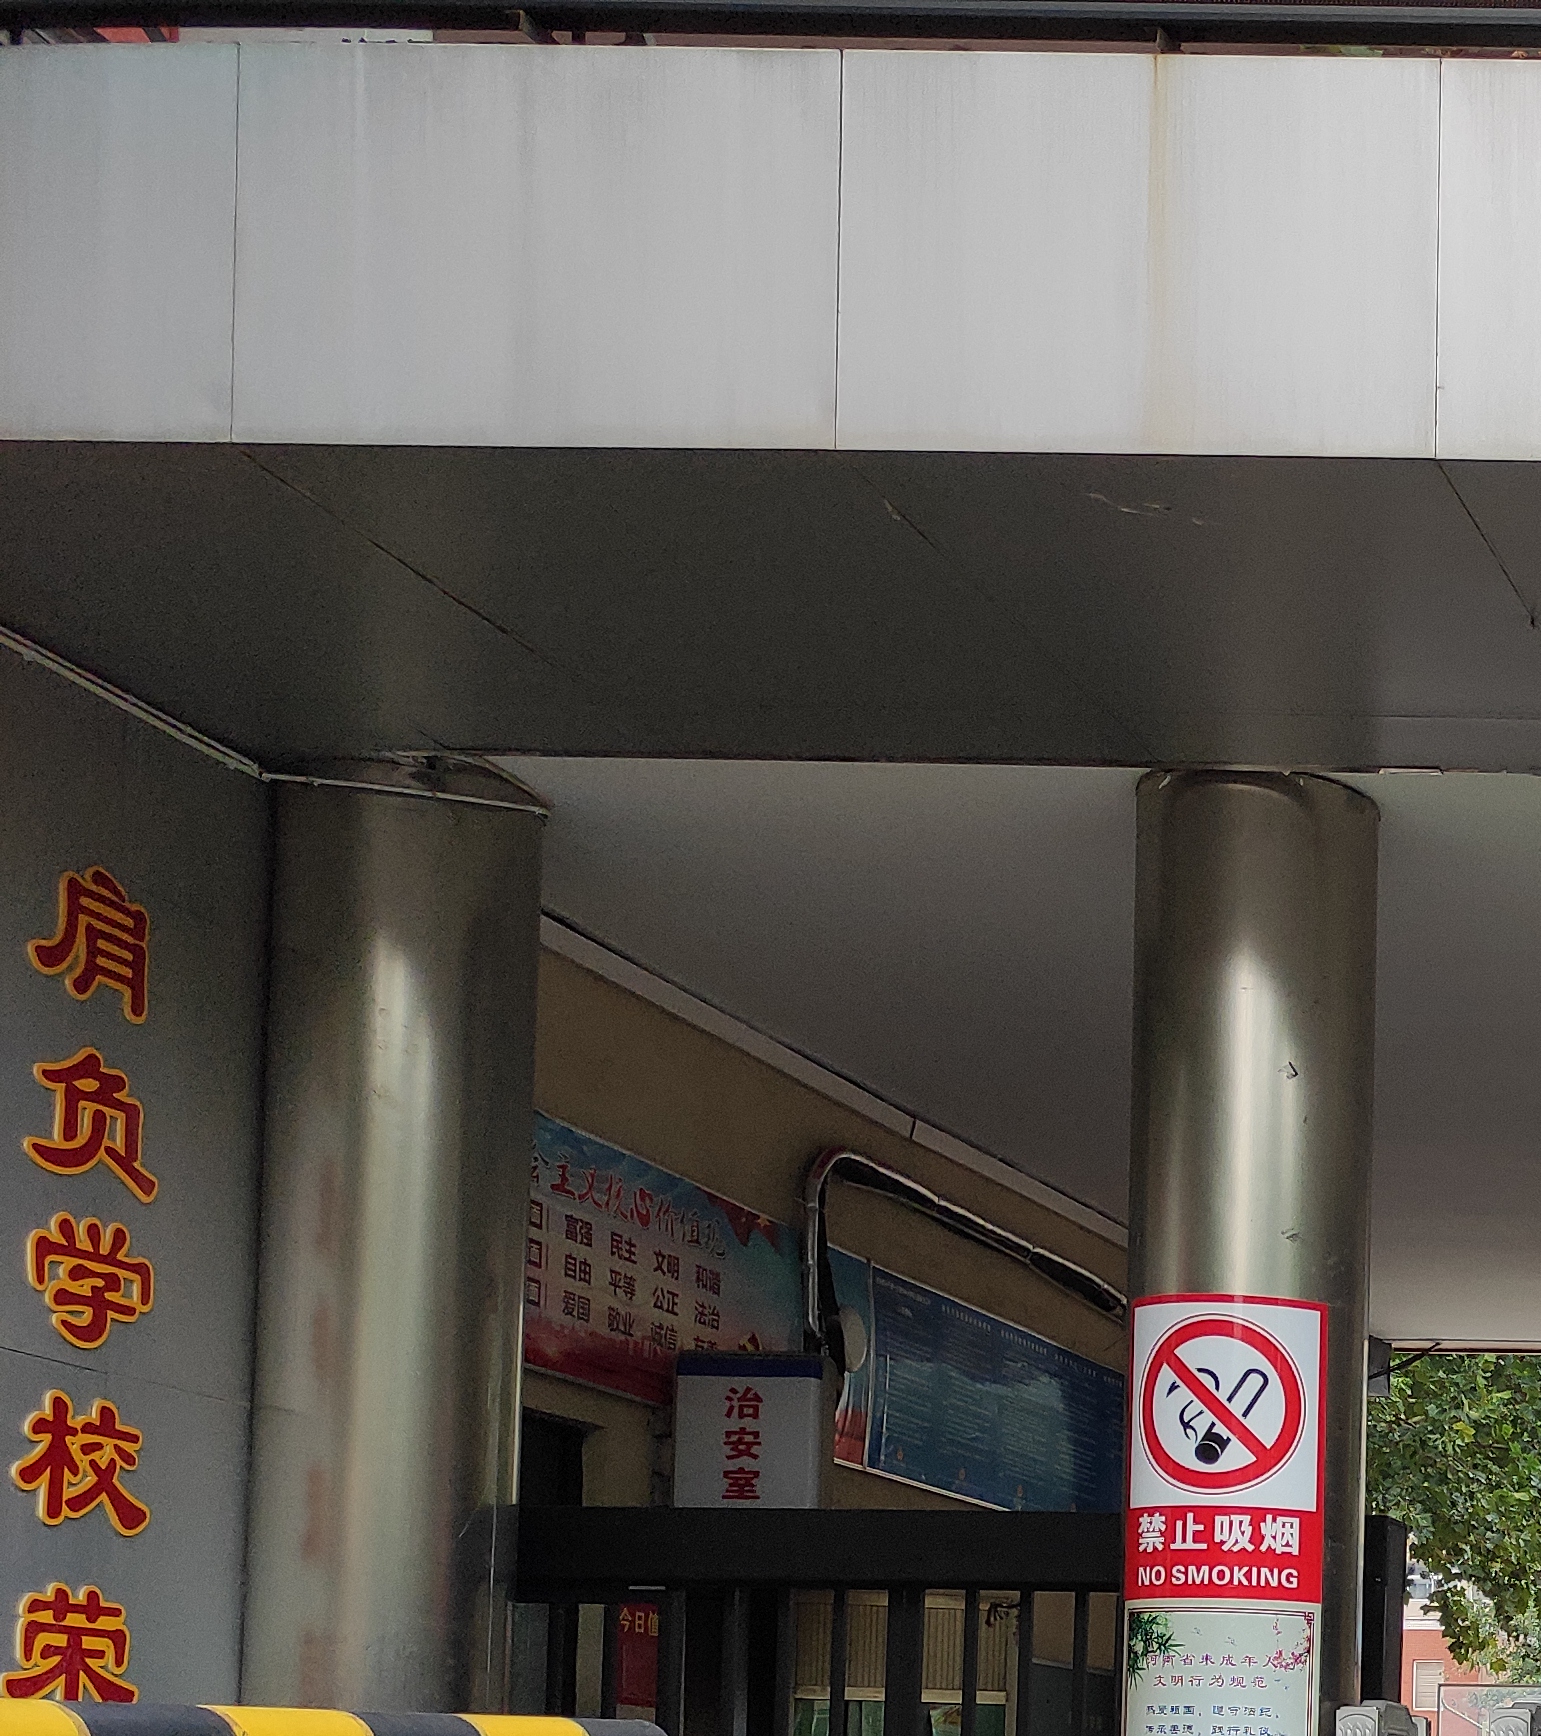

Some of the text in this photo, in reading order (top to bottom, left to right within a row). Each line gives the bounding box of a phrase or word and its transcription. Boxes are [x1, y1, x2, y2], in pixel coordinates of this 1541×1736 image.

[565, 1214, 721, 1298] 富强 民主 文明 和谐
[562, 1290, 590, 1324] 爱国
[608, 1305, 635, 1338] 敬业
[650, 1322, 678, 1352] 诚信
[564, 1252, 721, 1331] 自由 平等 公正 法治
[723, 1386, 763, 1500] 治安室
[1138, 1512, 1300, 1556] 禁止吸烟
[1138, 1565, 1299, 1589] NO SMOKING
[1153, 1673, 1268, 1689] 文明行为规范
